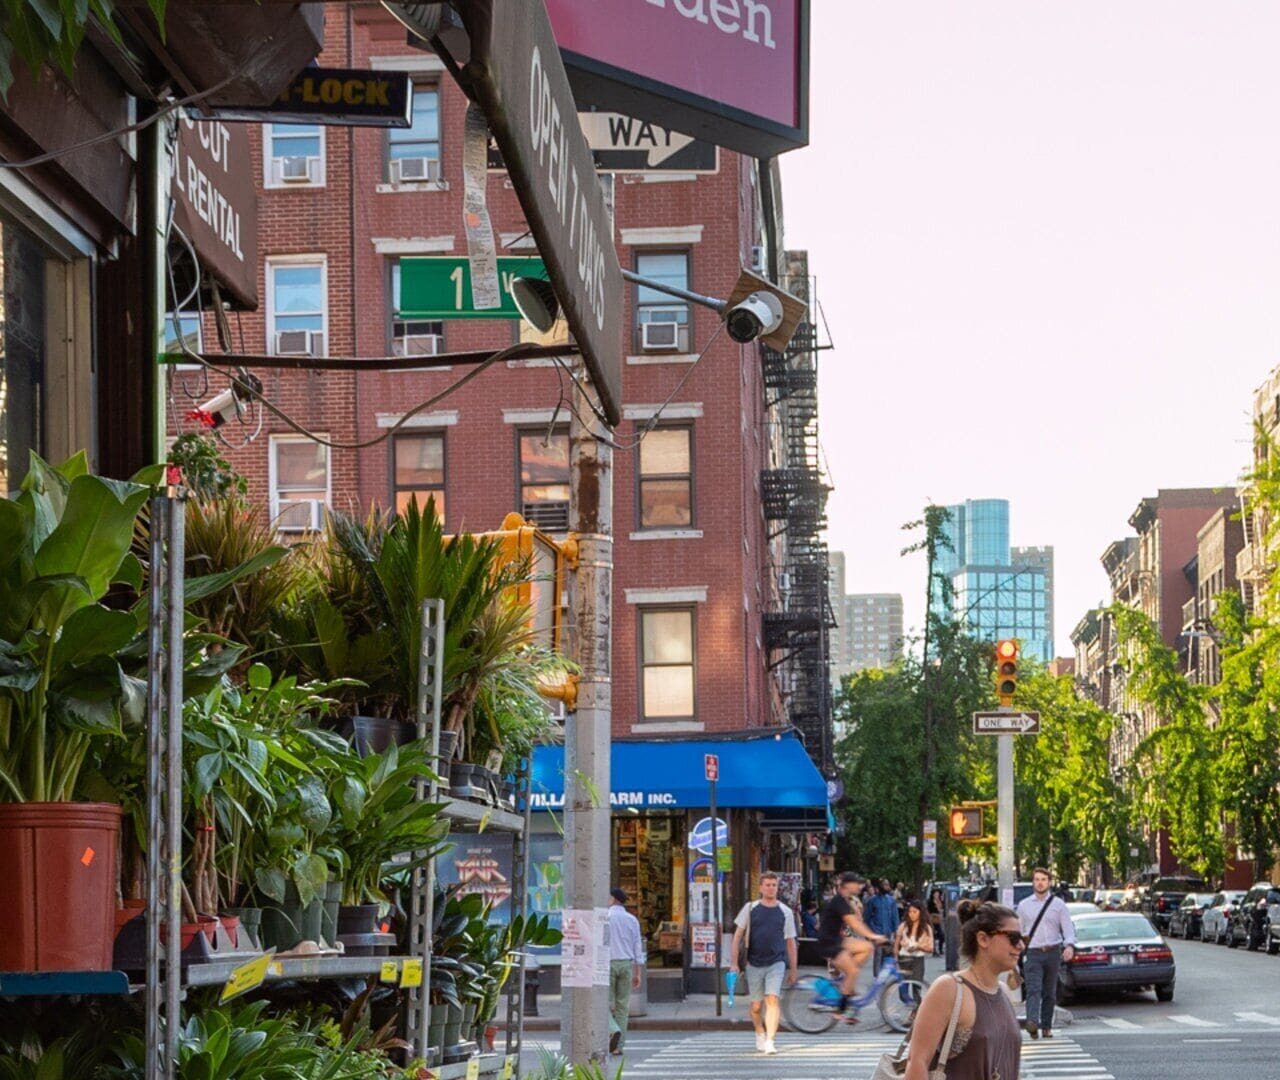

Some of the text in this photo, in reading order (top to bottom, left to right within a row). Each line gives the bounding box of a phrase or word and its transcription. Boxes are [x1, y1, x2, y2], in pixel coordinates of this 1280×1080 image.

[280, 78, 390, 106] -LOCK
[198, 120, 231, 172] CUT
[608, 117, 672, 147] WAY
[530, 46, 605, 330] OPEN 7 DAYS
[187, 156, 244, 262] RENTAL
[449, 266, 463, 310] 1
[983, 719, 1029, 728] ONE WAY
[647, 794, 677, 805] INC.
